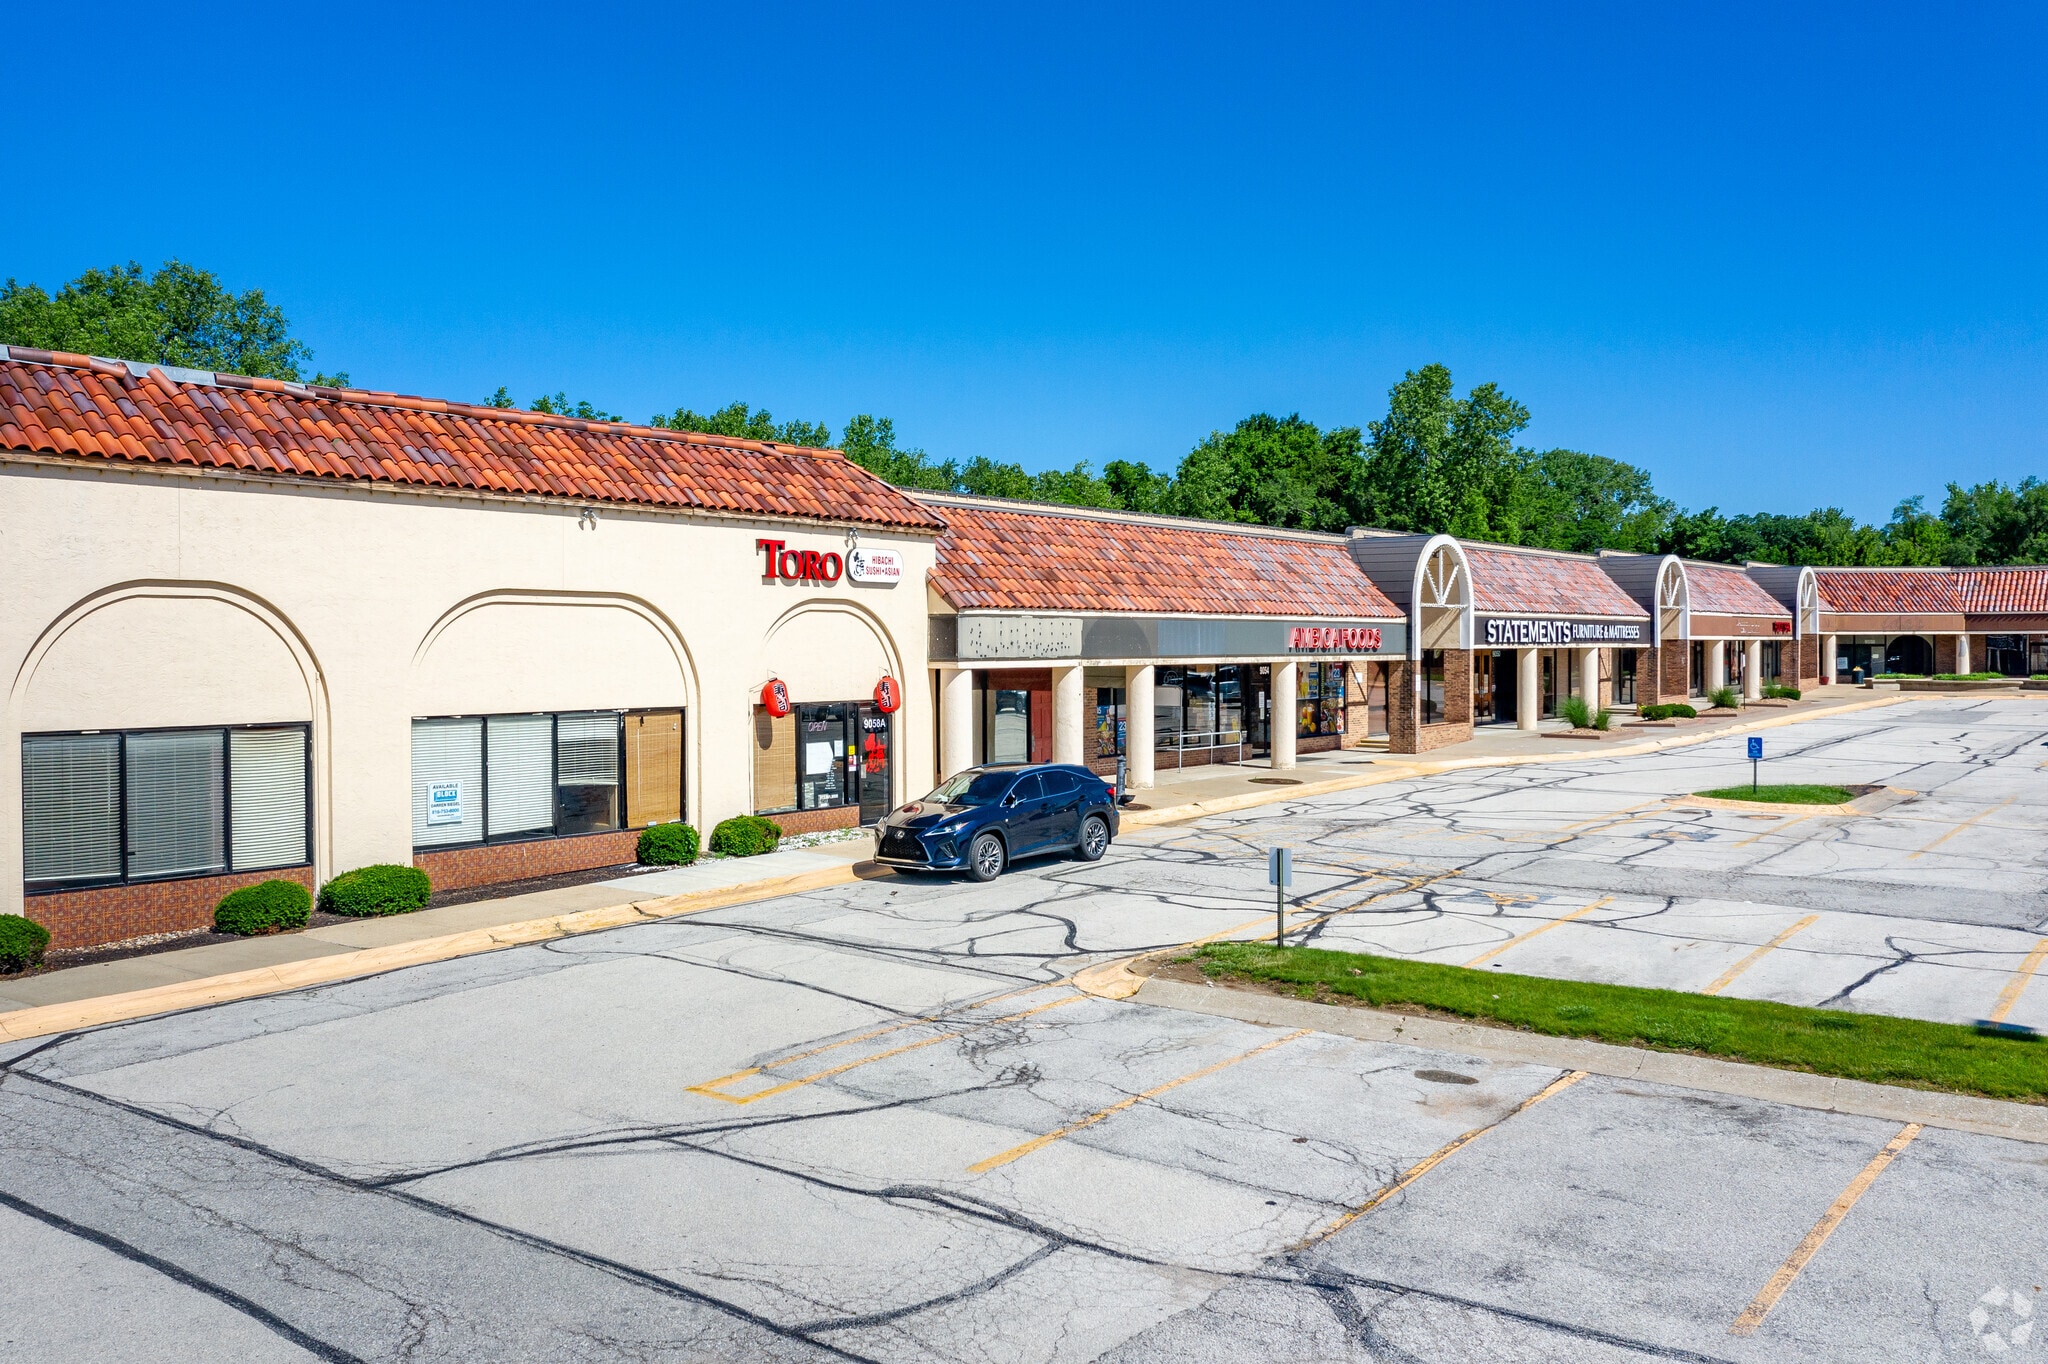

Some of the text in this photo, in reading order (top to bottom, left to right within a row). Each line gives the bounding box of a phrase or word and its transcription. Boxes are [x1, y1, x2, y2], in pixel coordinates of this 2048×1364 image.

[757, 538, 843, 581] TORO
[872, 555, 894, 566] HIBACHI
[1288, 627, 1382, 649] AMBICA FOODS
[1487, 619, 1640, 643] STATEMENTS FURNITURE & MATTRESSES
[807, 720, 828, 732] OPEN
[863, 718, 886, 729] 9058A
